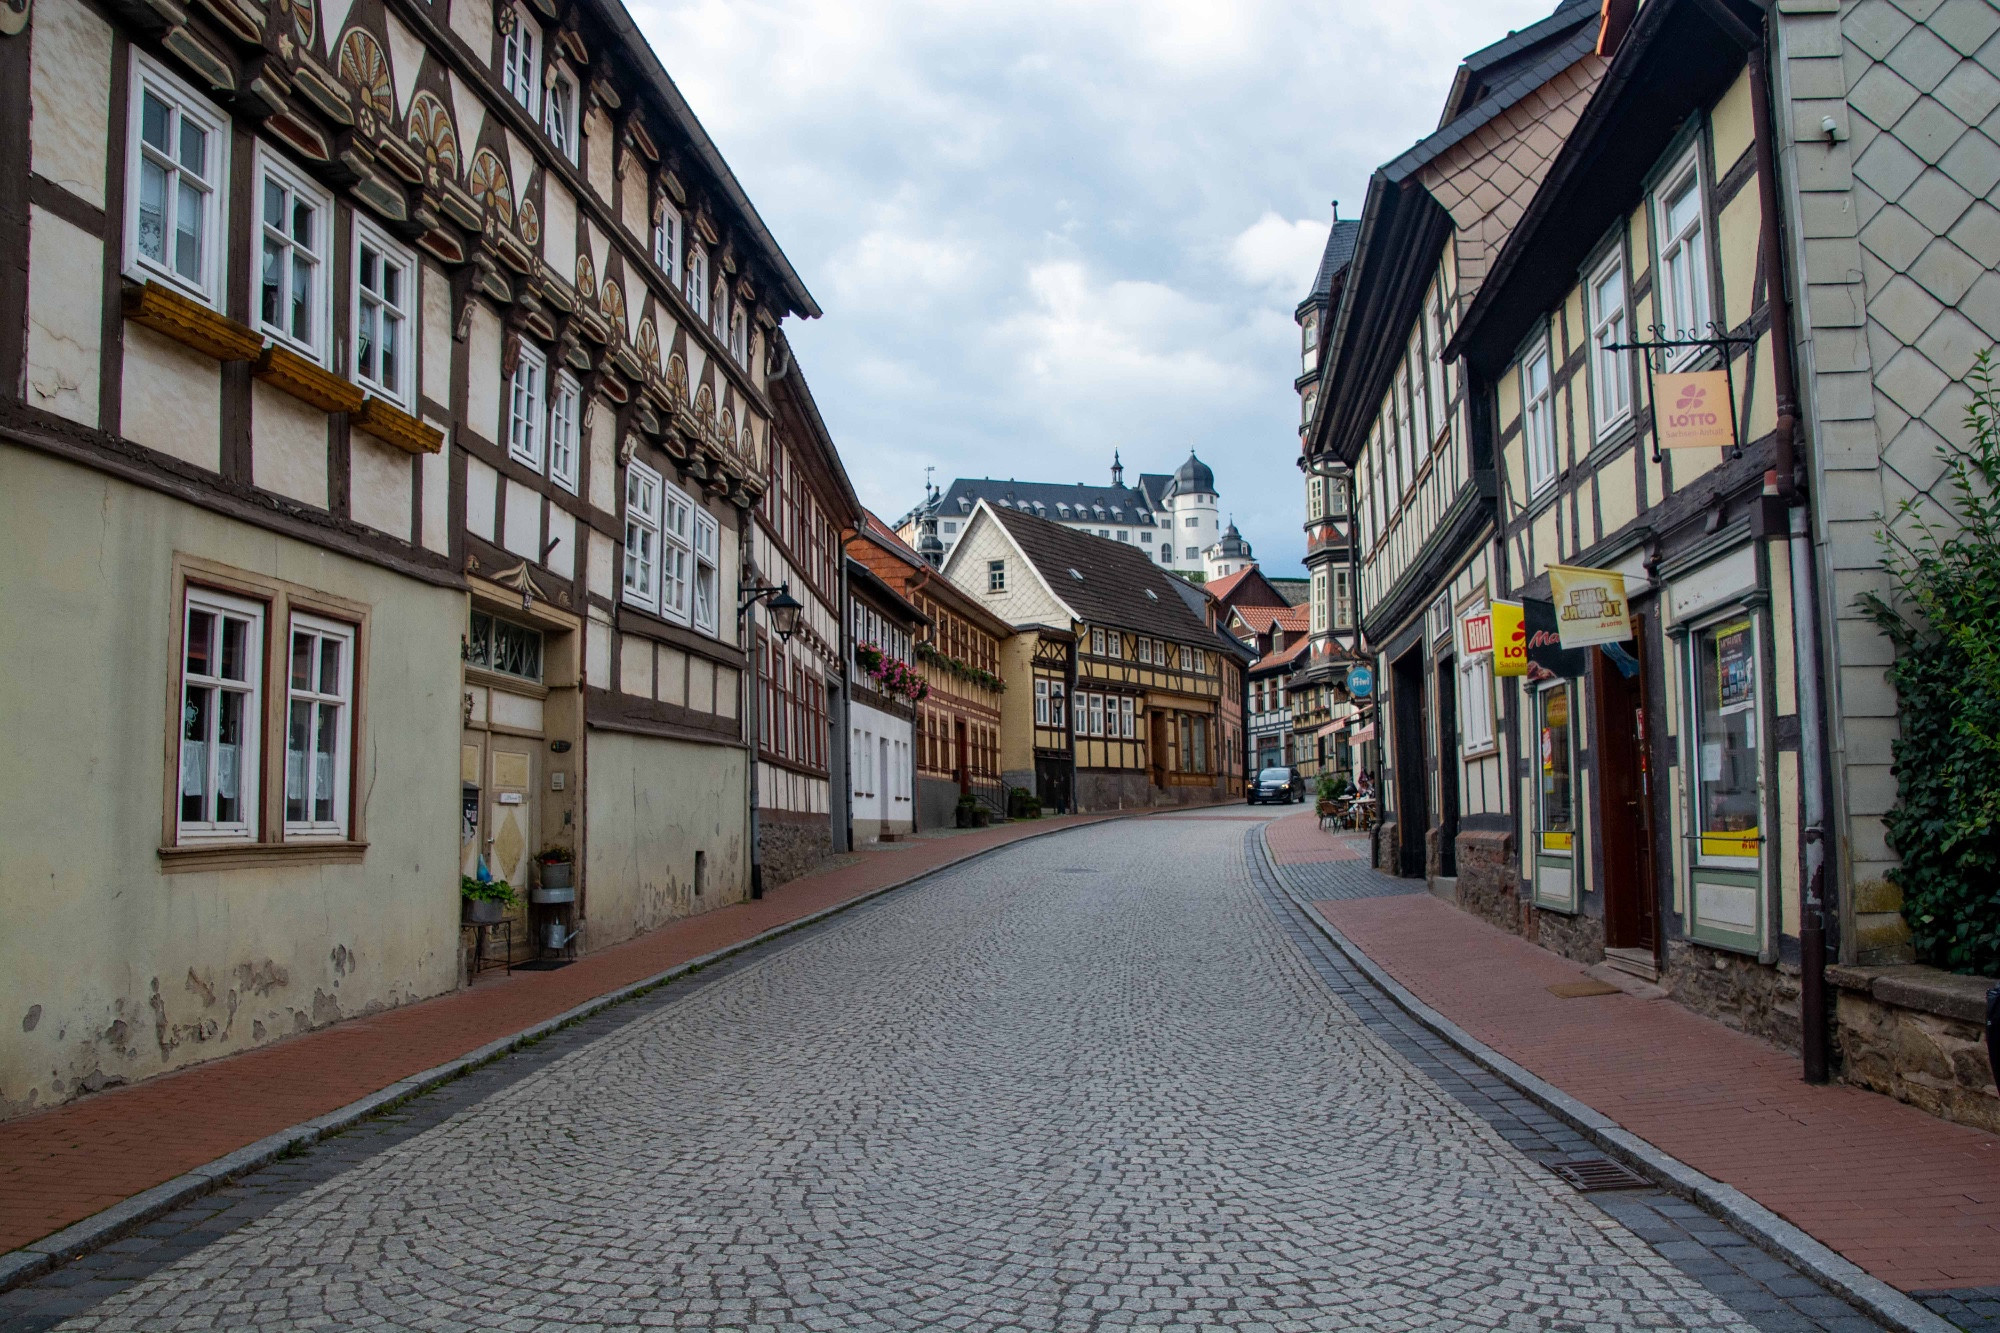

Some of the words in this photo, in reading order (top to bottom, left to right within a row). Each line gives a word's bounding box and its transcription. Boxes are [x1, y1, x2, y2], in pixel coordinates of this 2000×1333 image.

[1669, 413, 1717, 427] LOTTO
[1570, 587, 1607, 605] EURO
[1561, 600, 1621, 621] JACKPOT
[1469, 619, 1490, 648] Bild
